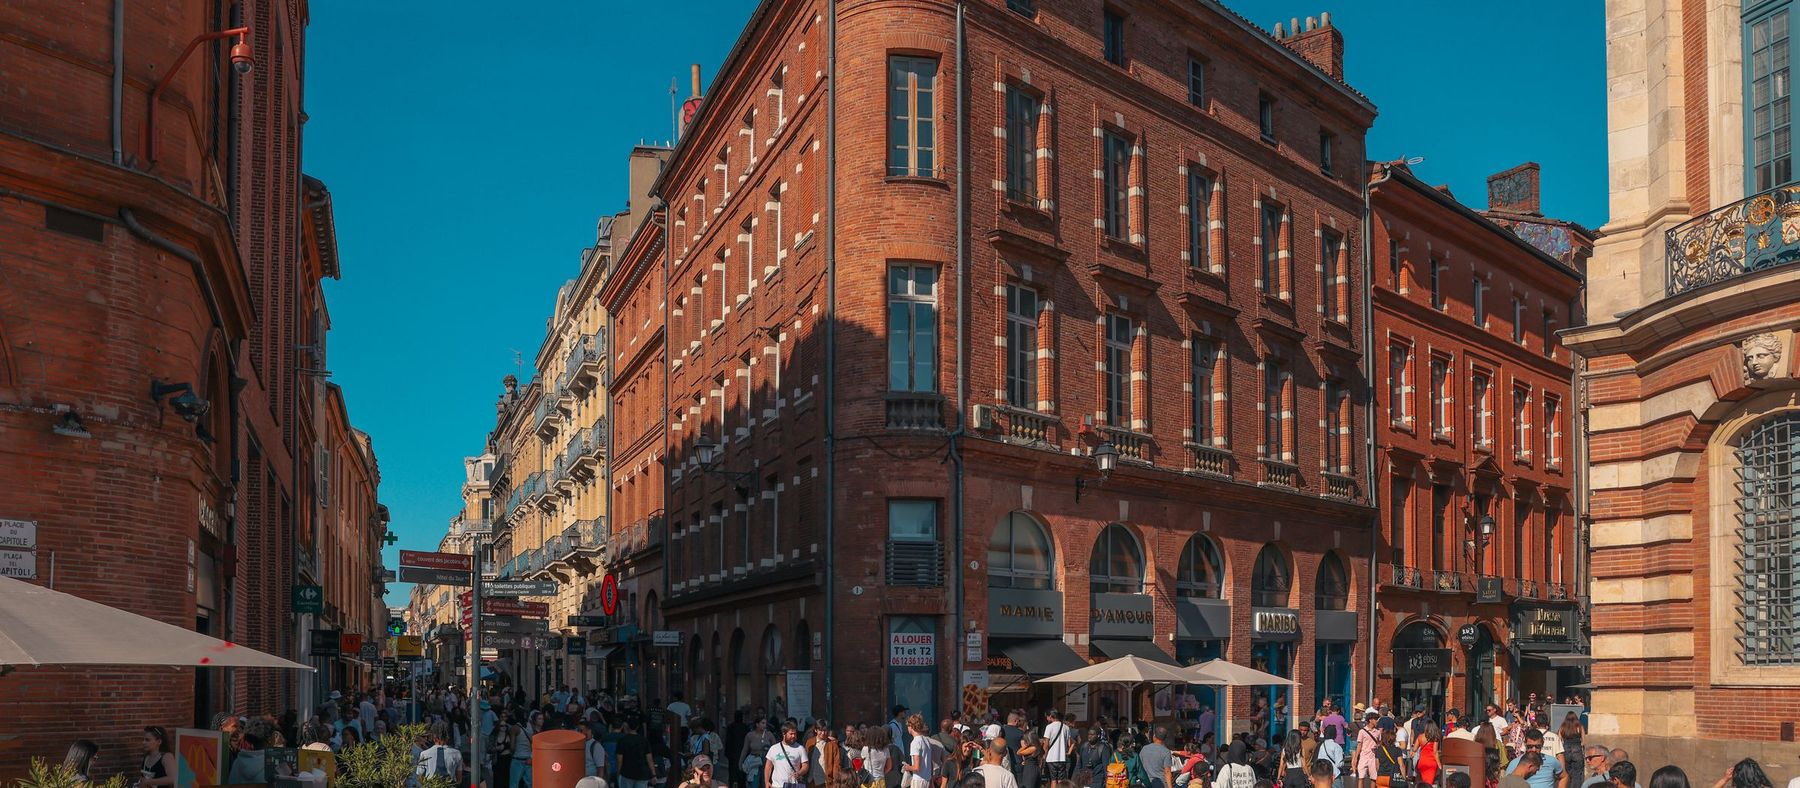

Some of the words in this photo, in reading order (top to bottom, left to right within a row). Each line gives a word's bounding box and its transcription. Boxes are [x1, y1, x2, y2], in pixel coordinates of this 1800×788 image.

[0, 537, 28, 546] CAPITOLE
[0, 567, 30, 576] APITOLI
[1000, 605, 1053, 619] MAMIE
[1091, 608, 1153, 622] D'AMOUR
[1256, 612, 1297, 633] HARIBO
[902, 635, 932, 643] LOUER
[894, 647, 904, 655] T1
[920, 647, 931, 655] T2
[1423, 655, 1438, 663] ebisu
